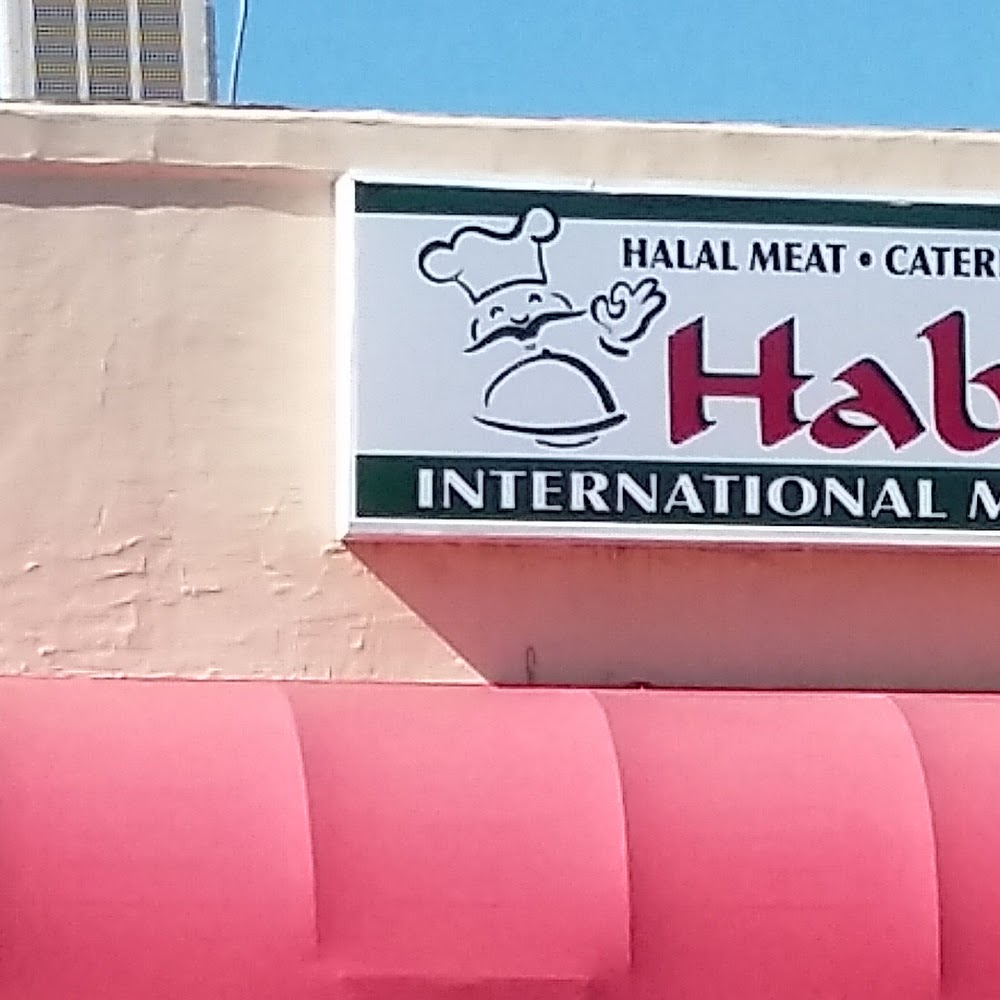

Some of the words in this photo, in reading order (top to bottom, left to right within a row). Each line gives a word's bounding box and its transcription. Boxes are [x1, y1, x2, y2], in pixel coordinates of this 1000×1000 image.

[623, 237, 739, 271] HALAL
[749, 240, 847, 274] MEAT
[416, 467, 948, 519] INTERNATIONAL
